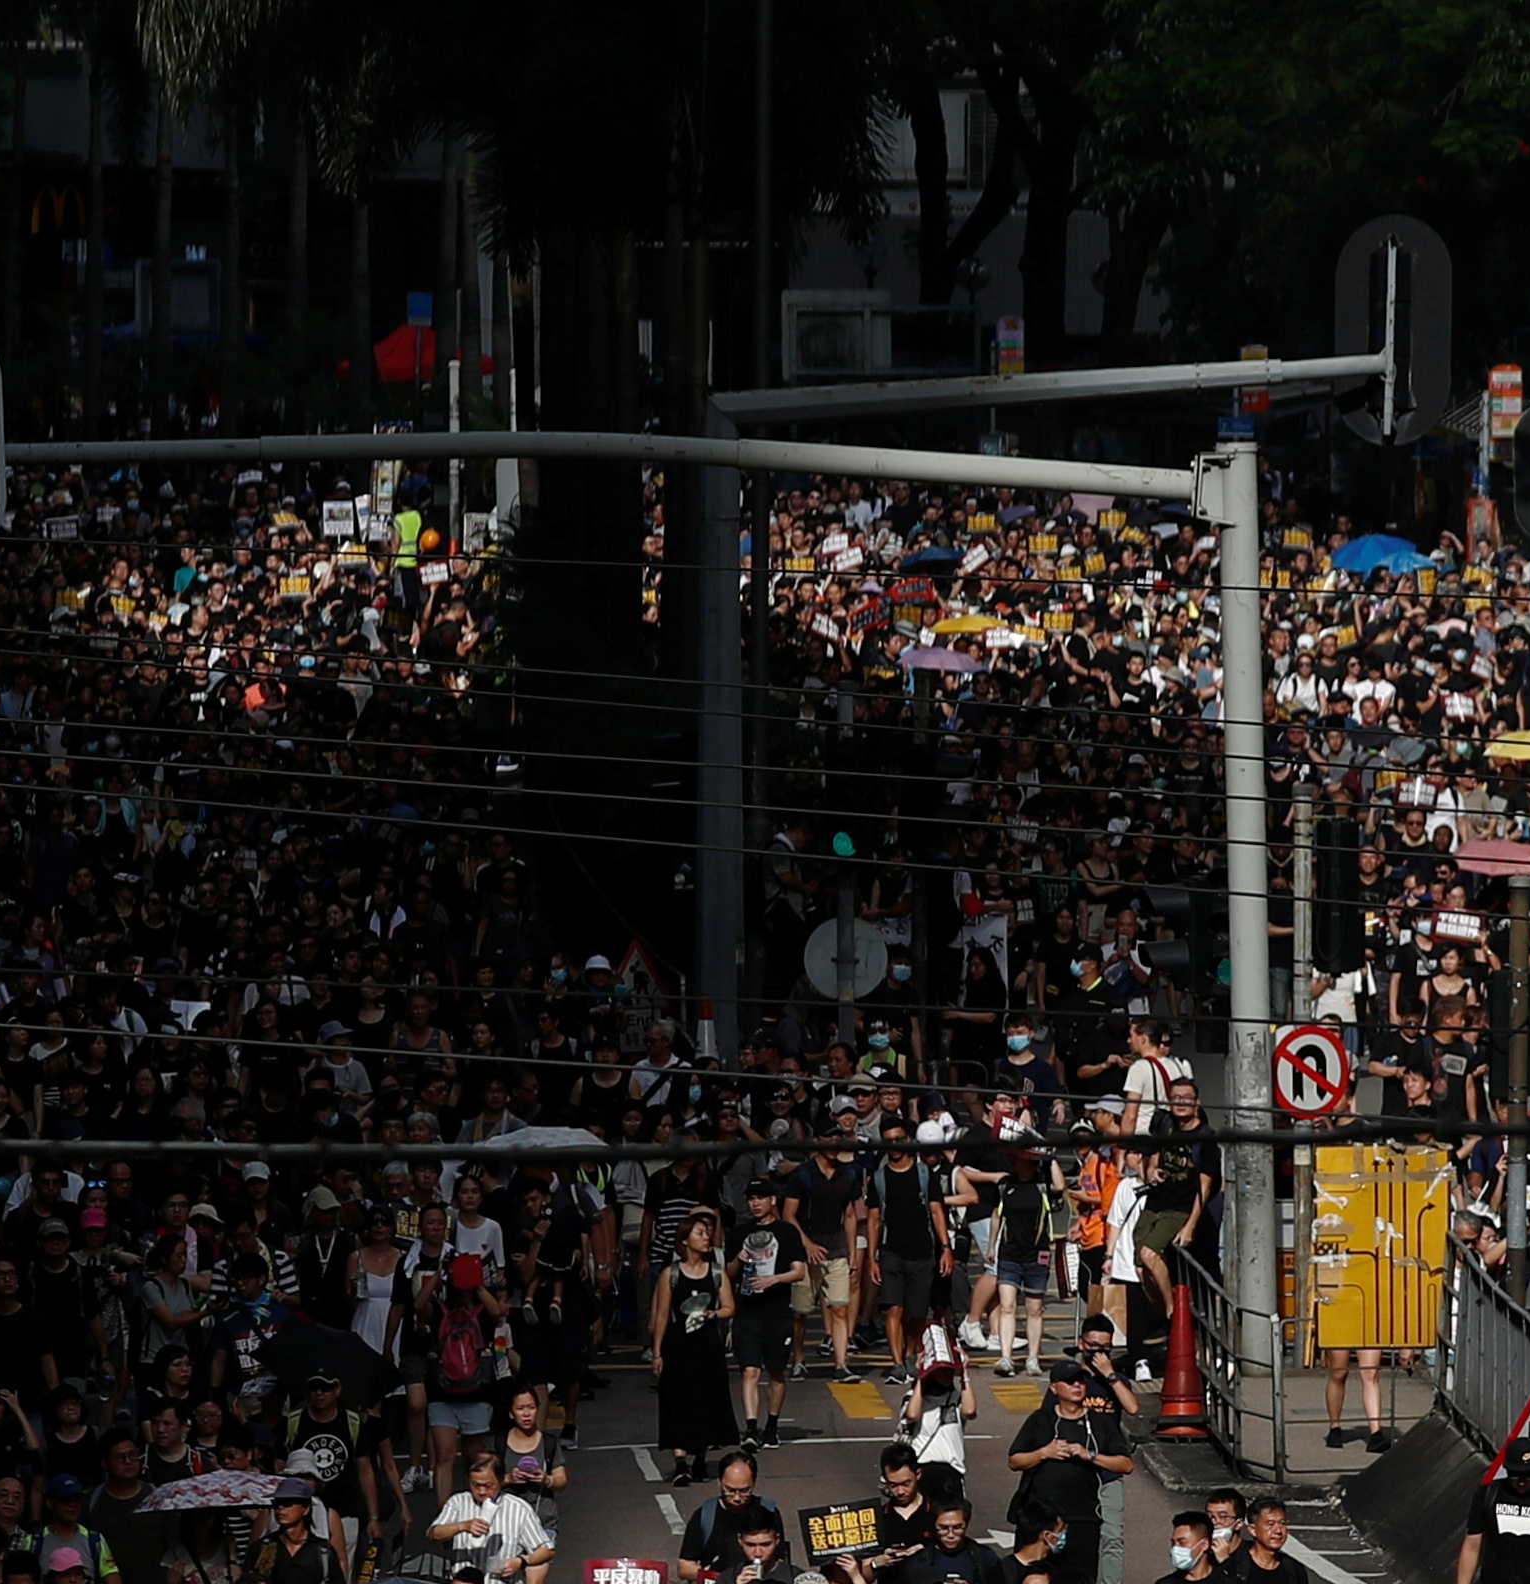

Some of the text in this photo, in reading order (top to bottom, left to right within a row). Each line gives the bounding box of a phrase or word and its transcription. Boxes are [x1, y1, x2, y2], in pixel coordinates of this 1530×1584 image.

[809, 1507, 877, 1535] 全面撤回
[1495, 1502, 1520, 1516] HONG
[811, 1525, 879, 1551] 送中惡法
